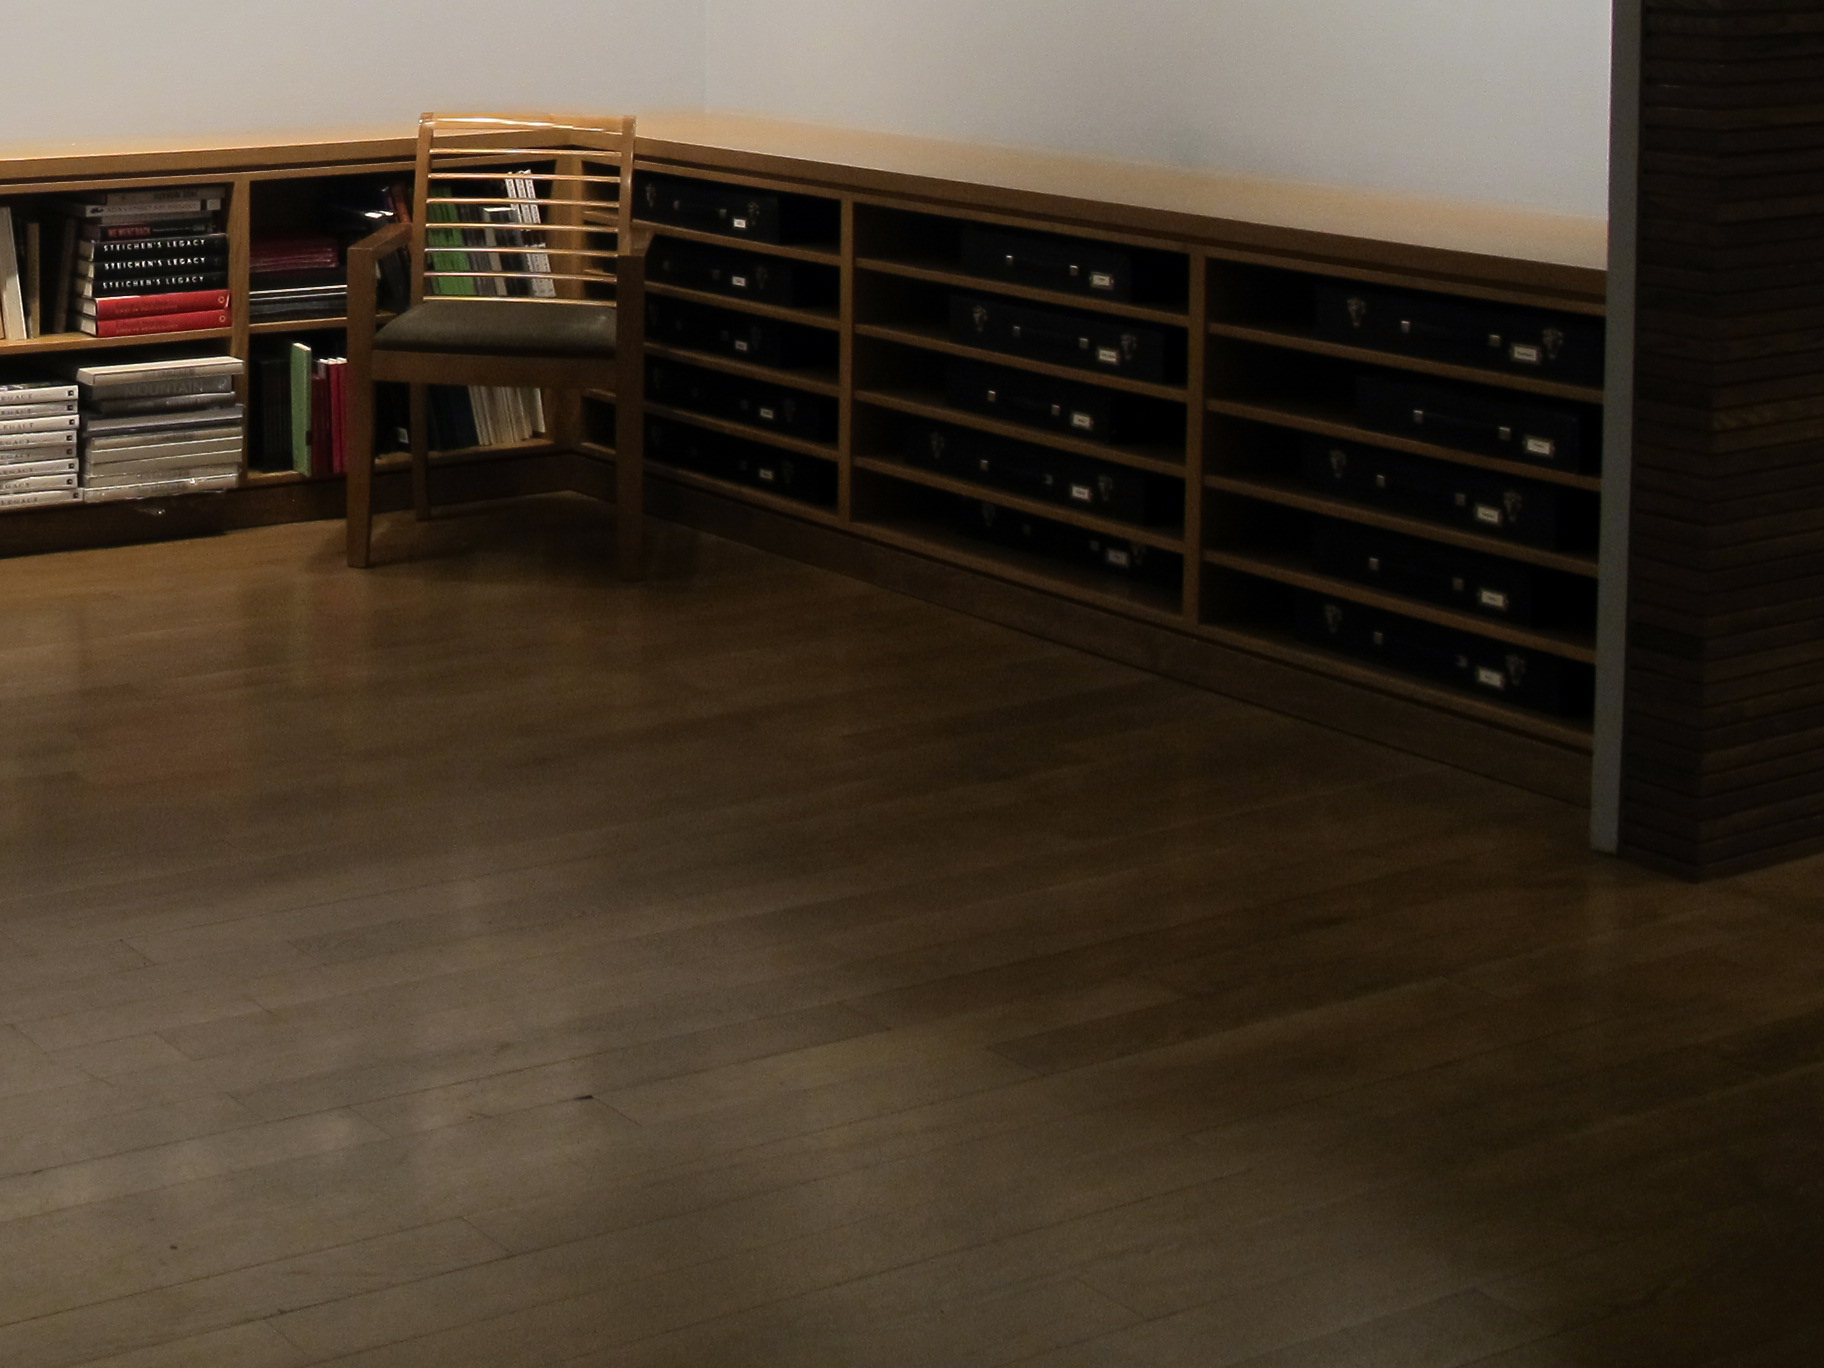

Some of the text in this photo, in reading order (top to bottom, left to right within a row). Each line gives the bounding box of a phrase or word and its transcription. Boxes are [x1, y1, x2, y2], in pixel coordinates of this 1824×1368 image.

[103, 239, 206, 252] STEICHEN'S LEGACY
[104, 257, 206, 270] STEICHEN'S LEGACY
[102, 276, 204, 289] STEICHEN'S LEGACY
